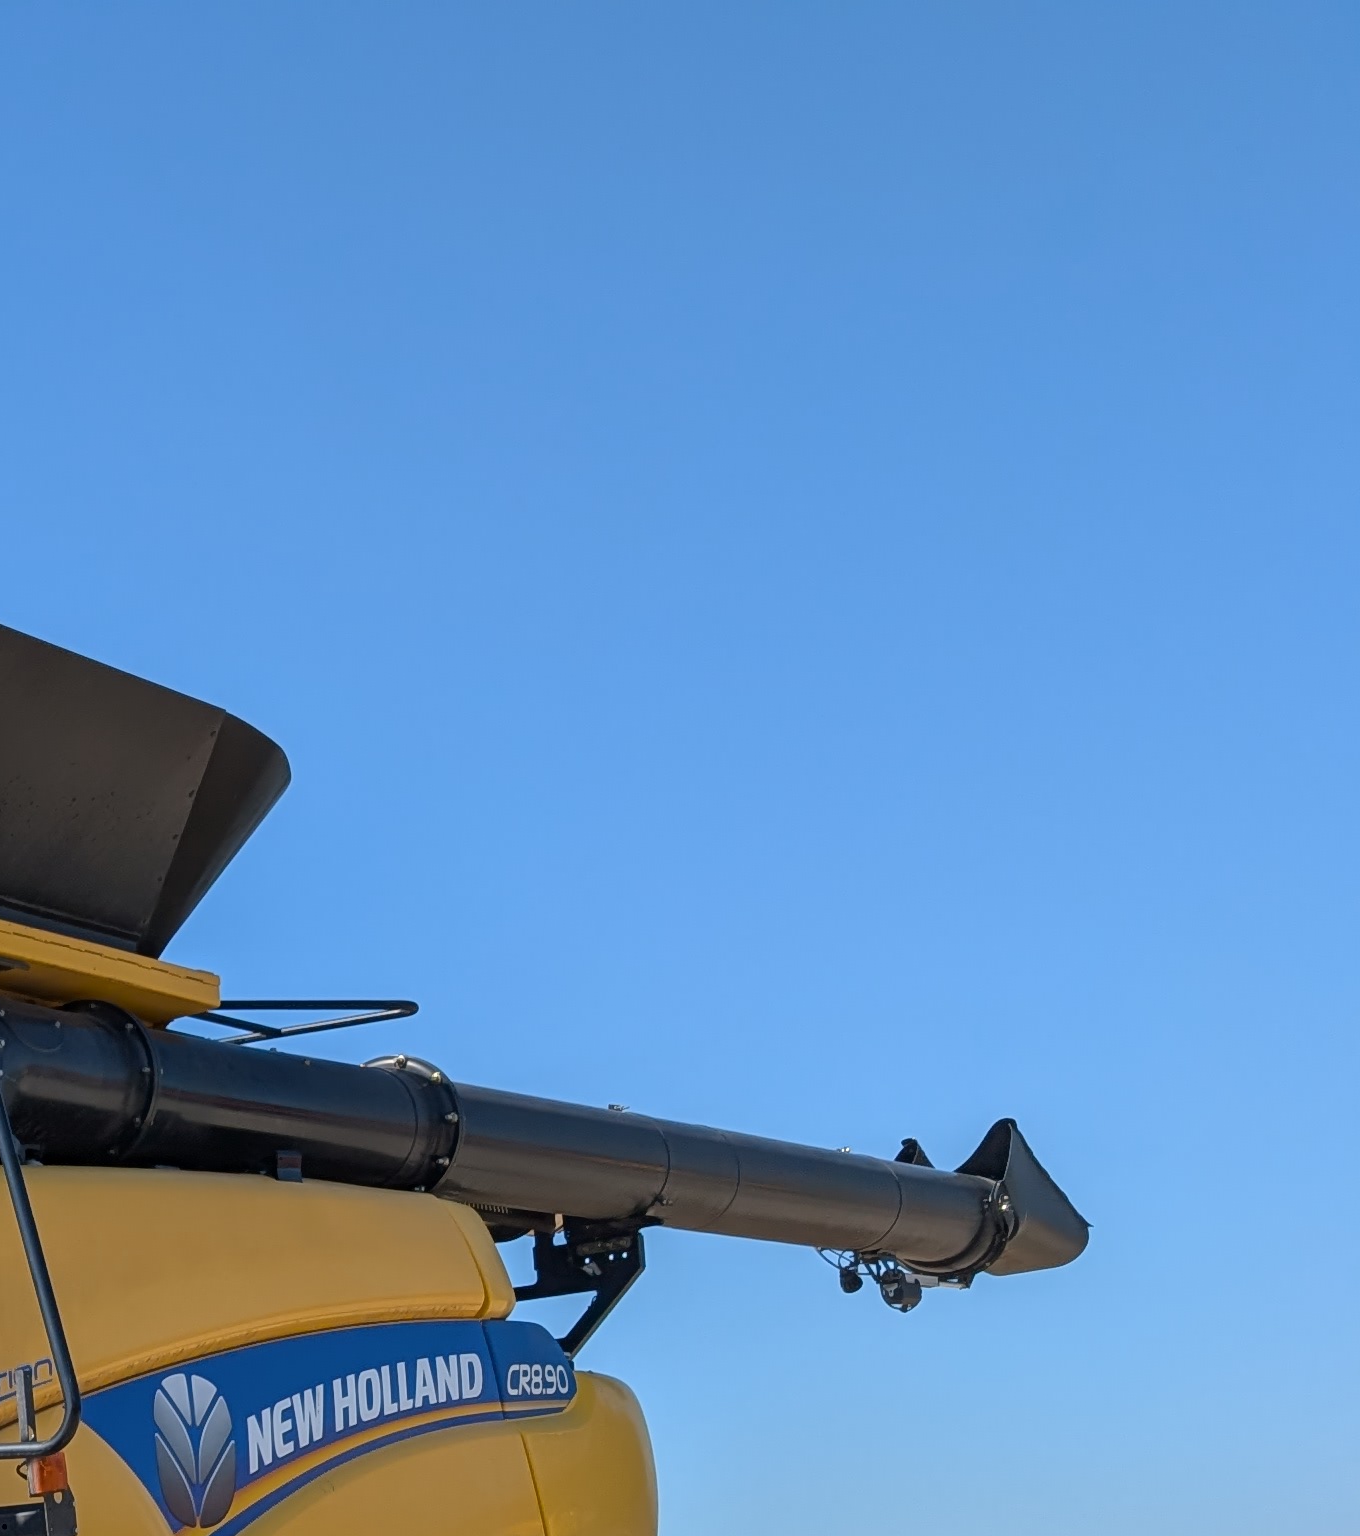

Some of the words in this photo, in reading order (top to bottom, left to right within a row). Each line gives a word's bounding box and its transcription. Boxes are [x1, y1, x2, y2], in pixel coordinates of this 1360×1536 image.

[246, 1383, 324, 1475] NEW
[332, 1353, 483, 1433] HOLLAND
[506, 1363, 569, 1395] CR8.90
